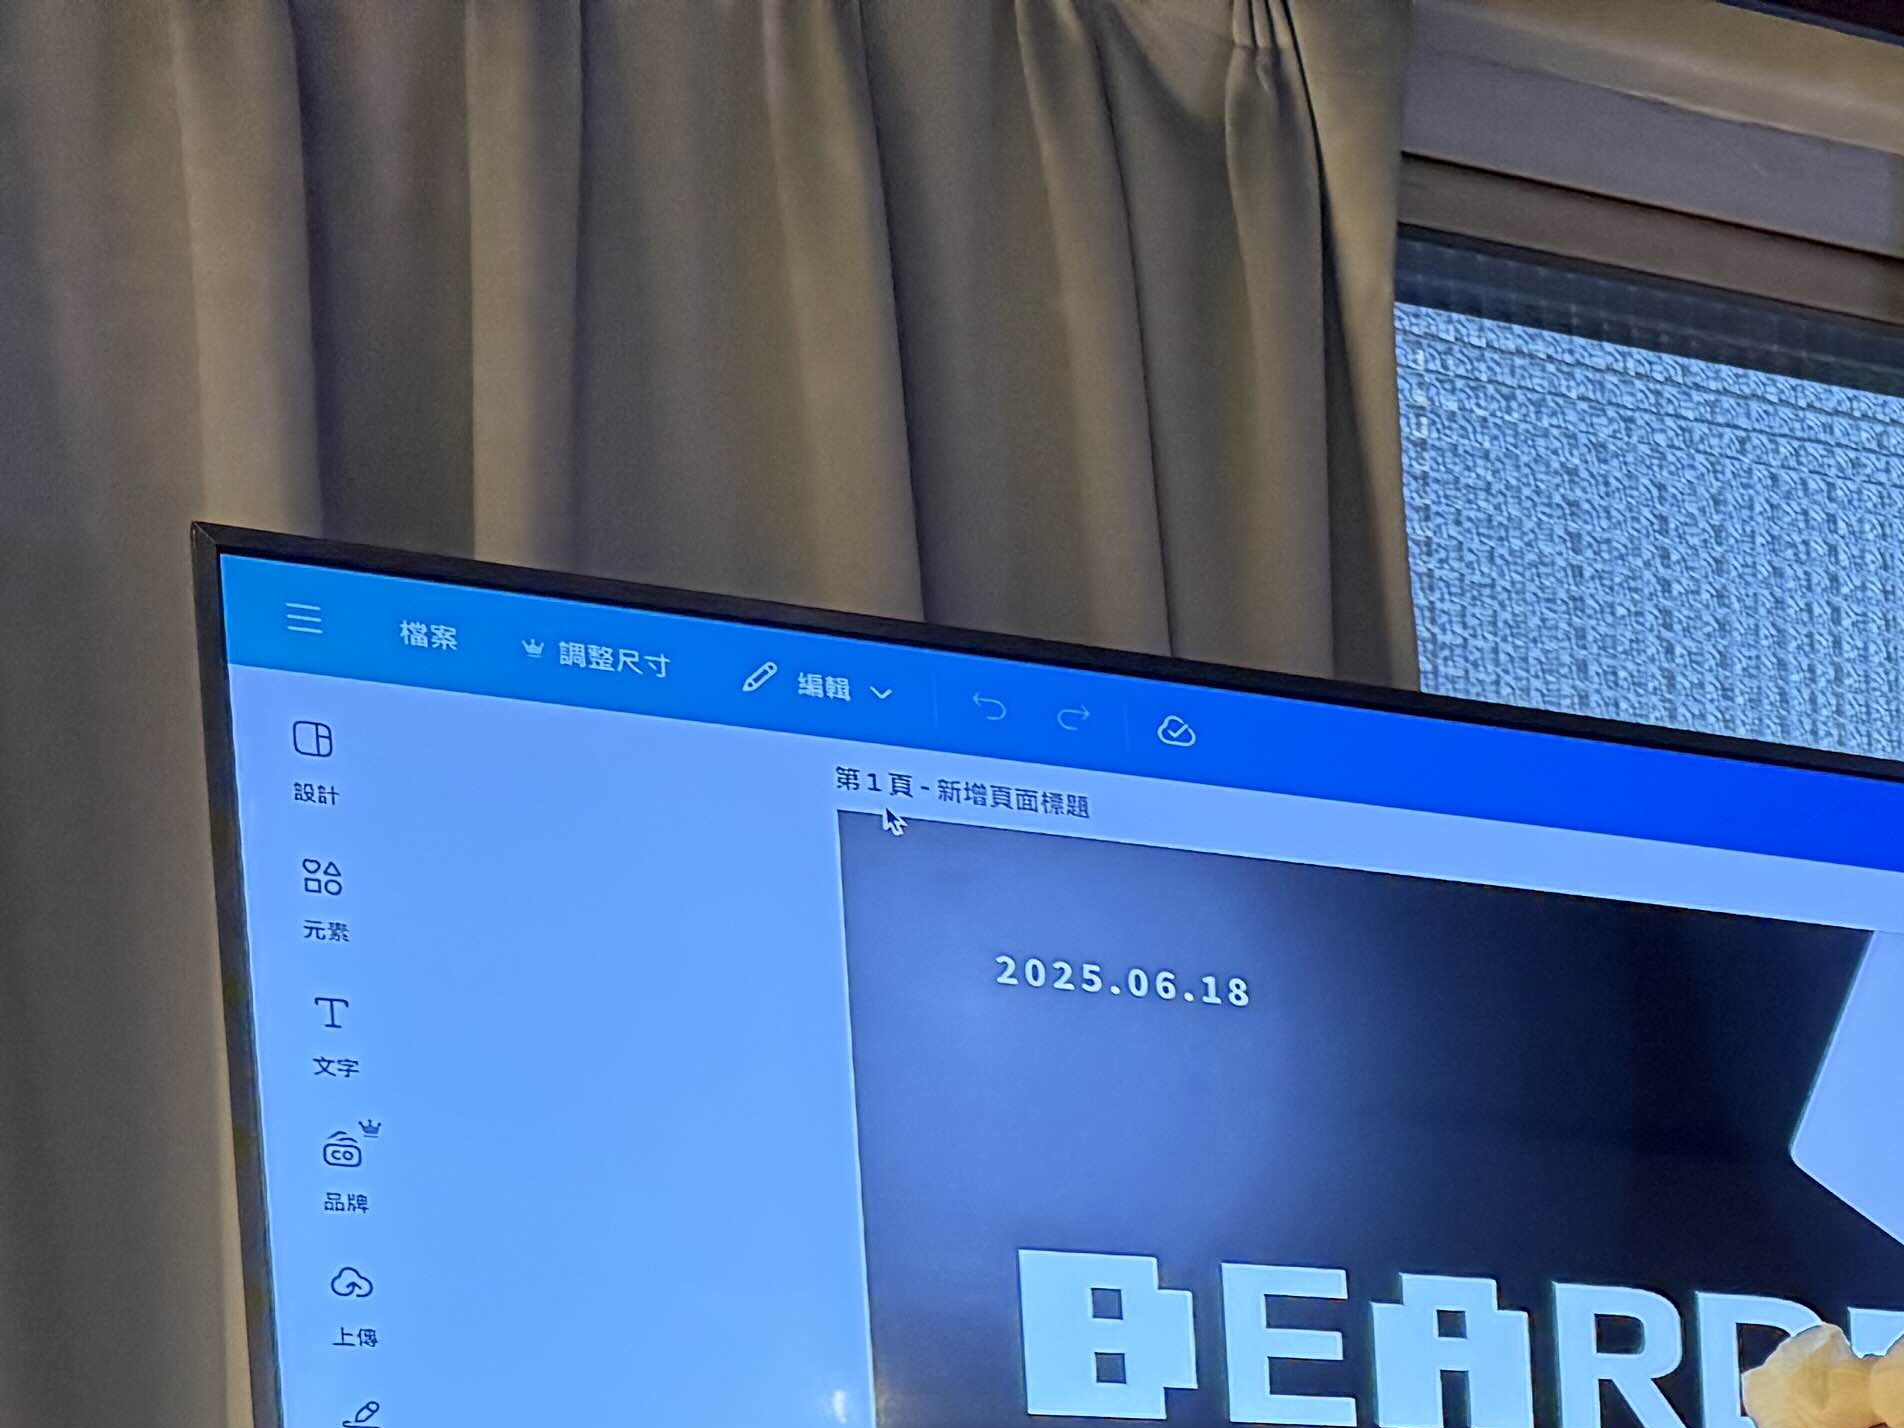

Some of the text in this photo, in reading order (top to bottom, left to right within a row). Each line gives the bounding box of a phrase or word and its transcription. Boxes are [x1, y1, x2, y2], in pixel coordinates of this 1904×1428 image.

[399, 620, 458, 651] 檔案
[558, 640, 671, 680] 調整尺寸
[797, 672, 851, 703] 編輯
[292, 782, 340, 806] 設計
[937, 777, 1090, 821] 新增頁面標題
[302, 920, 351, 944] 元素
[994, 955, 1250, 1007] 2025.06.18
[313, 1055, 360, 1078] 文字
[323, 1192, 370, 1214] 品牌
[332, 1327, 379, 1348] 上傳
